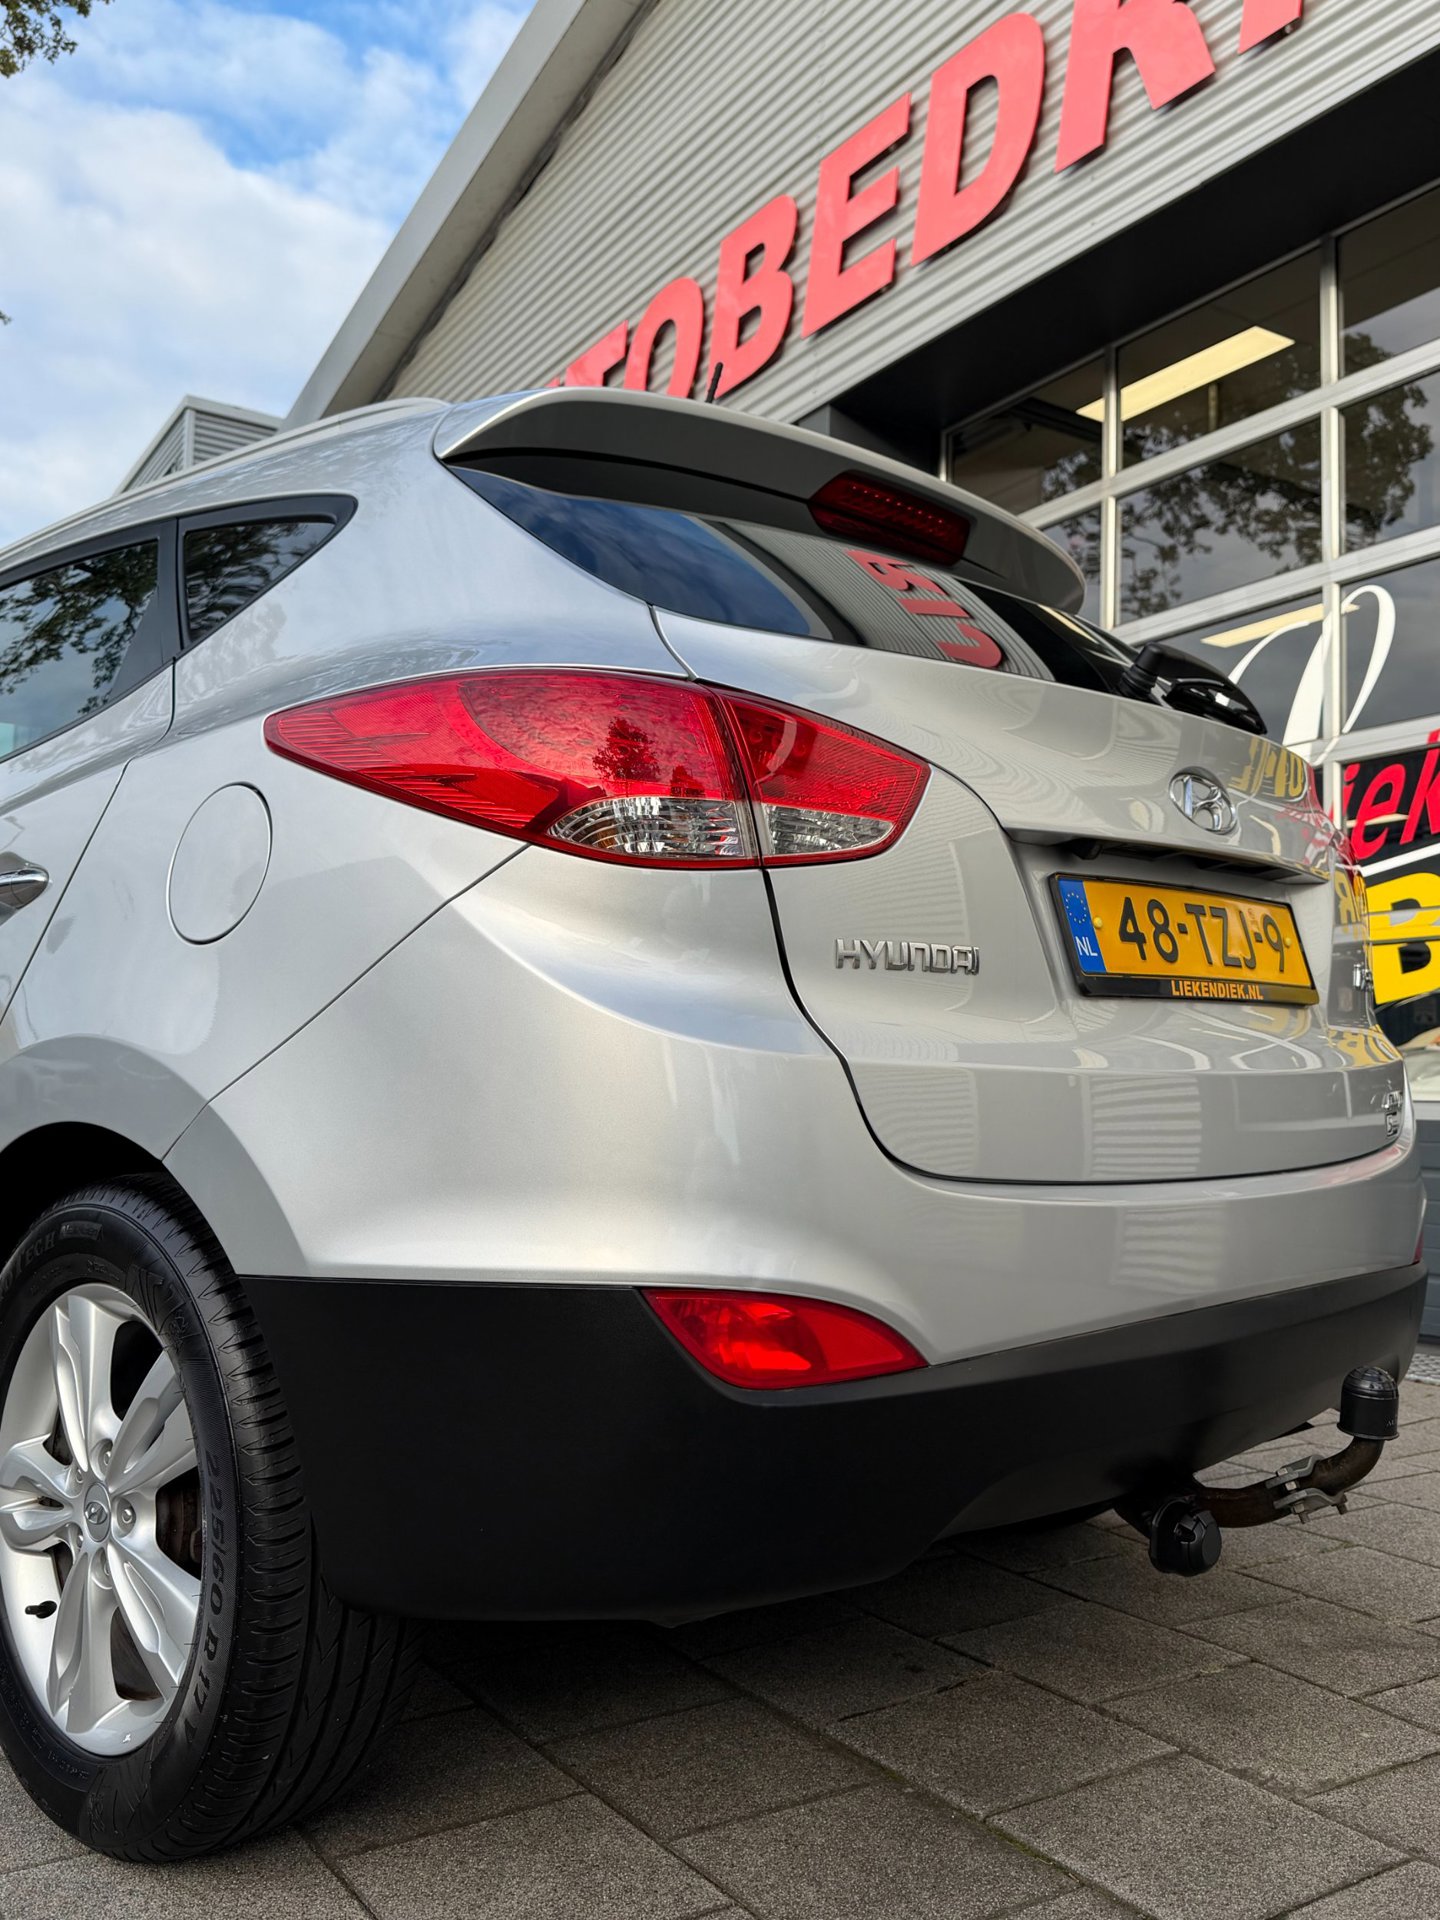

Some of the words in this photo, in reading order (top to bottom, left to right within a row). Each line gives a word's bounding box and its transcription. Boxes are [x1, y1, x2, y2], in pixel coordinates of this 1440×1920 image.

[834, 938, 980, 975] HYUNDAI
[1075, 936, 1098, 957] NL
[1171, 979, 1264, 1000] LIEKENDIEK.NL
